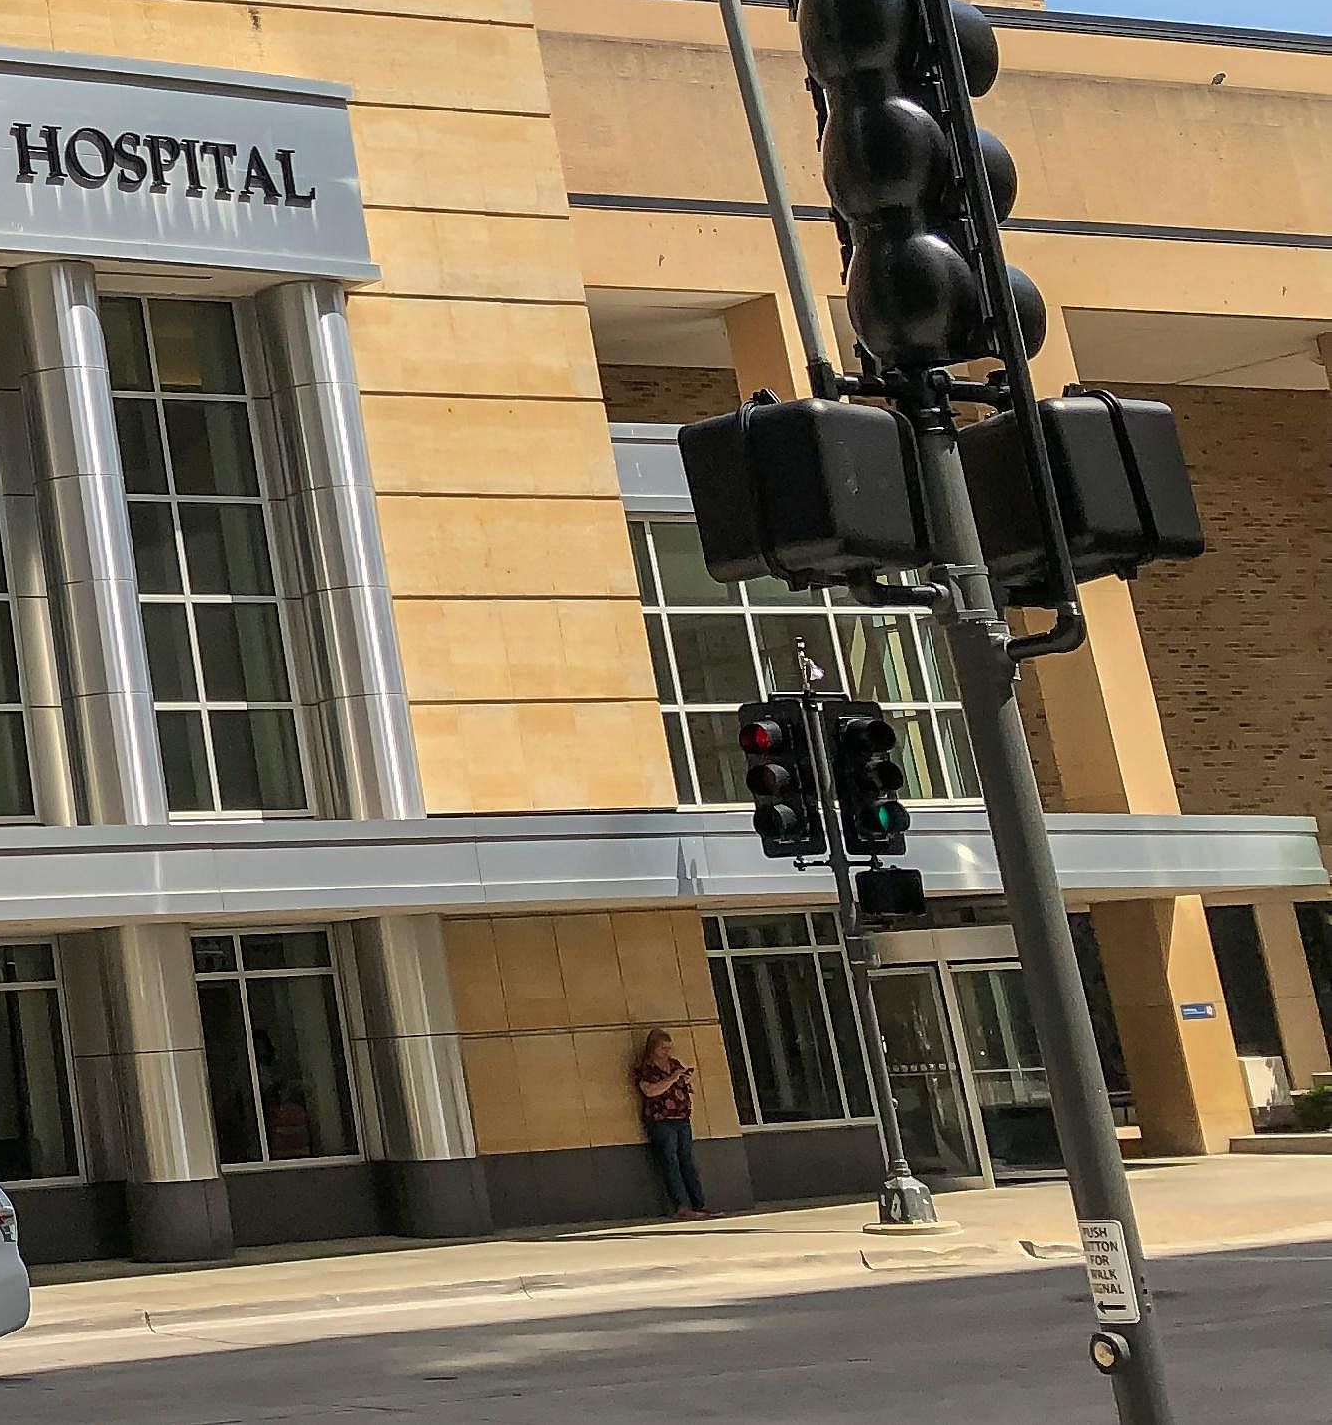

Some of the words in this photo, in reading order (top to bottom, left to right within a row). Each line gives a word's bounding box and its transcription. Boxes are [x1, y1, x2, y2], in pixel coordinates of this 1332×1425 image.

[11, 121, 317, 203] HOSPITAL
[1082, 1227, 1108, 1238] PUSH
[1085, 1241, 1119, 1252] TTON
[1089, 1254, 1110, 1266] FOR
[1092, 1282, 1125, 1295] NAL
